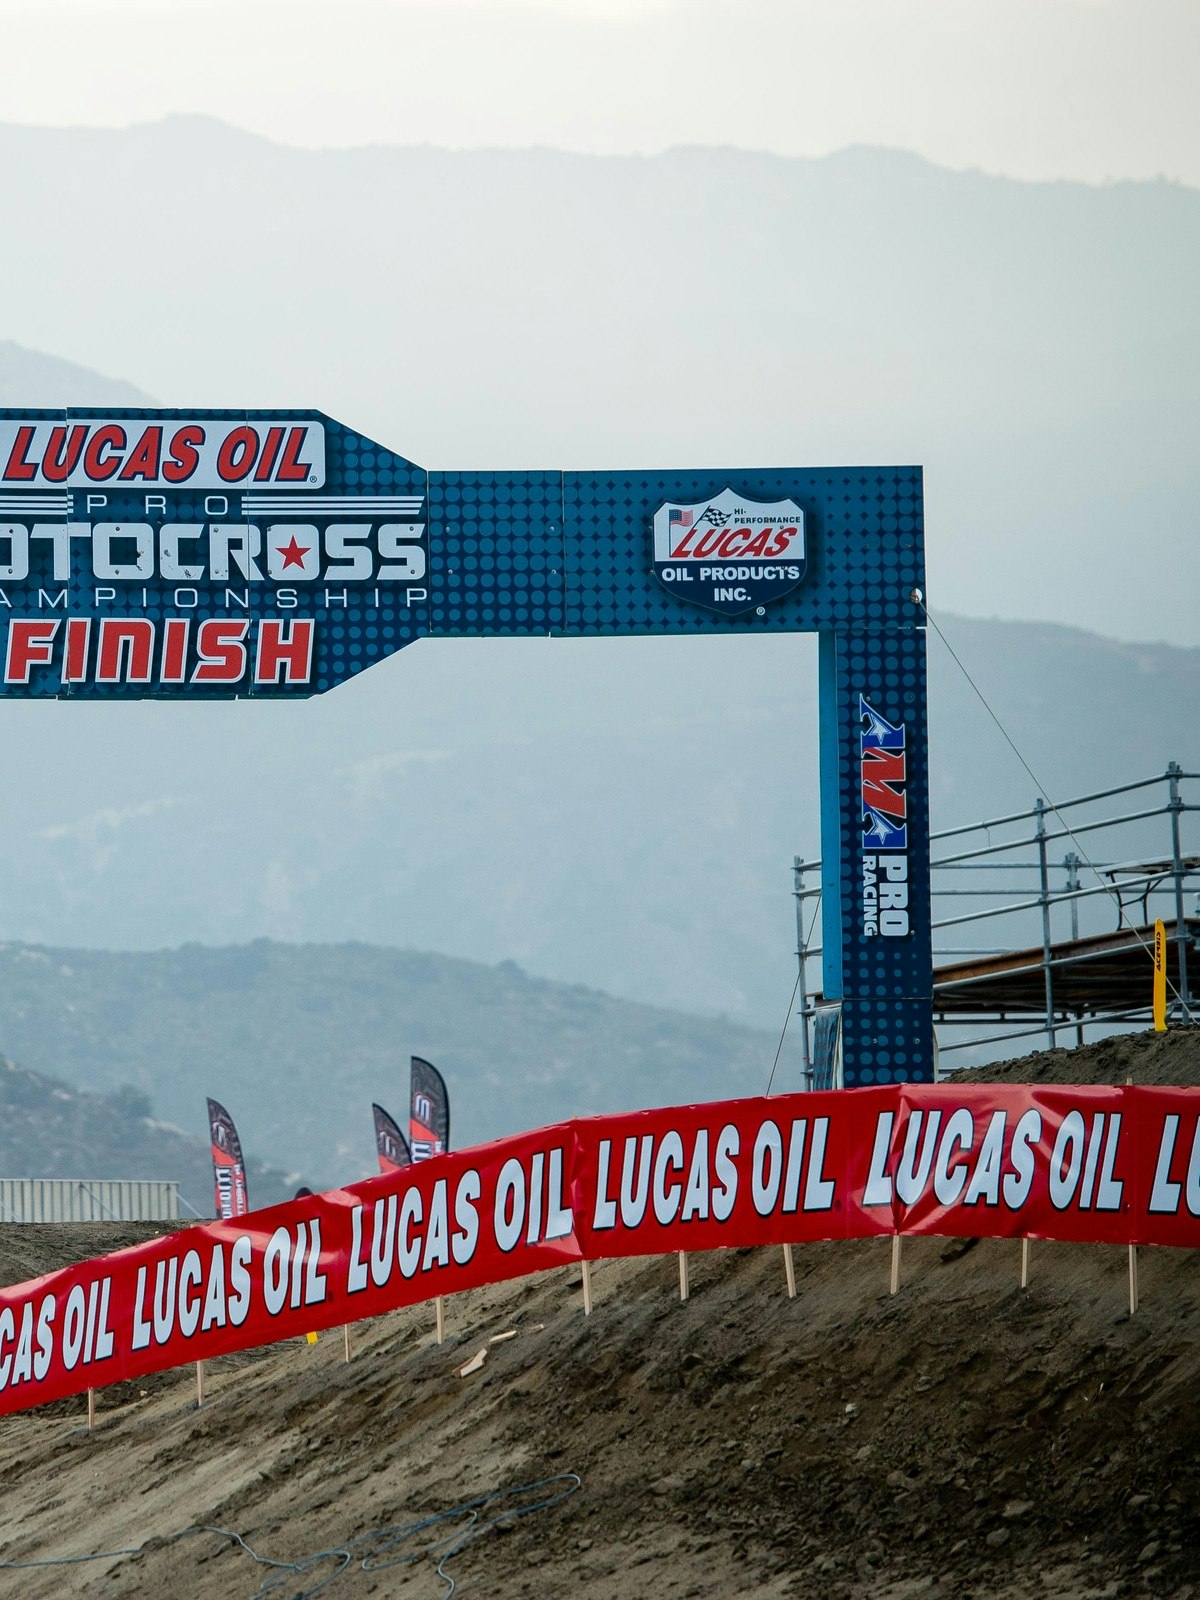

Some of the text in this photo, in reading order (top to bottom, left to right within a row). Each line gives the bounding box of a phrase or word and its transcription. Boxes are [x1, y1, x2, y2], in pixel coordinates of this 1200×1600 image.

[2, 424, 314, 483] LUCAS OIL
[87, 496, 228, 515] PRO
[734, 516, 801, 524] PERFORMANCE
[670, 527, 798, 558] LUCAS
[661, 565, 800, 582] OIL PRODUCTS
[714, 587, 752, 601] INC.
[3, 617, 316, 685] FINISH
[860, 693, 907, 849] AMA
[862, 855, 878, 936] RACING
[878, 855, 909, 936] PRO
[62, 1277, 115, 1372] OIL
[131, 1235, 253, 1351] LUCAS
[263, 1218, 327, 1316] OIL
[346, 1168, 481, 1294] LUCAS
[493, 1148, 575, 1253] OIL
[592, 1124, 740, 1231] LUCAS
[751, 1117, 836, 1218] OIL
[863, 1107, 1043, 1209] LUCAS
[1048, 1108, 1124, 1212] OIL
